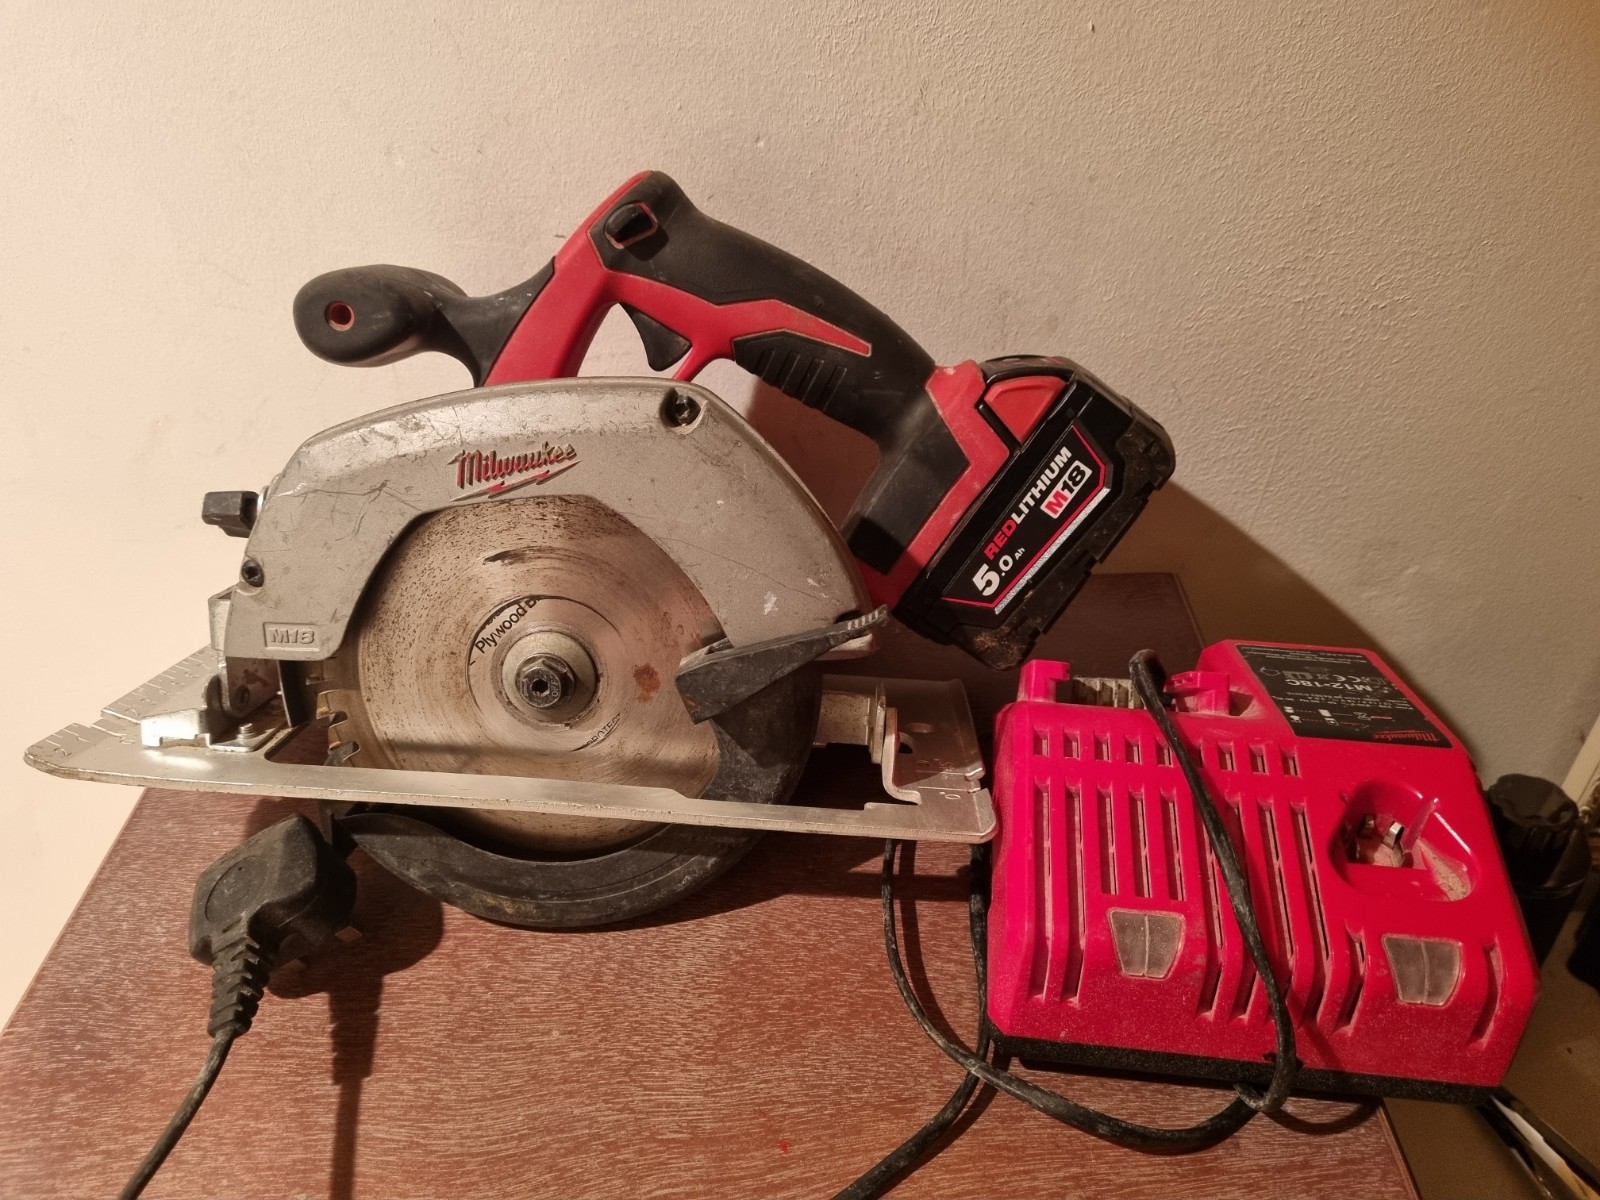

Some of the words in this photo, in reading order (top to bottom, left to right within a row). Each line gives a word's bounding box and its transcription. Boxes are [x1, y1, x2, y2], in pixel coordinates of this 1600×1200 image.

[447, 441, 577, 490] Milwaukee
[1044, 464, 1087, 516] M18
[984, 446, 1072, 560] REDLITHIUM
[972, 554, 1013, 596] 5.0
[1013, 547, 1025, 561] Ah
[268, 628, 315, 644] M18
[474, 602, 528, 653] Plywood
[1286, 678, 1373, 692] M12-18C
[1373, 729, 1440, 742] Milwaukee
